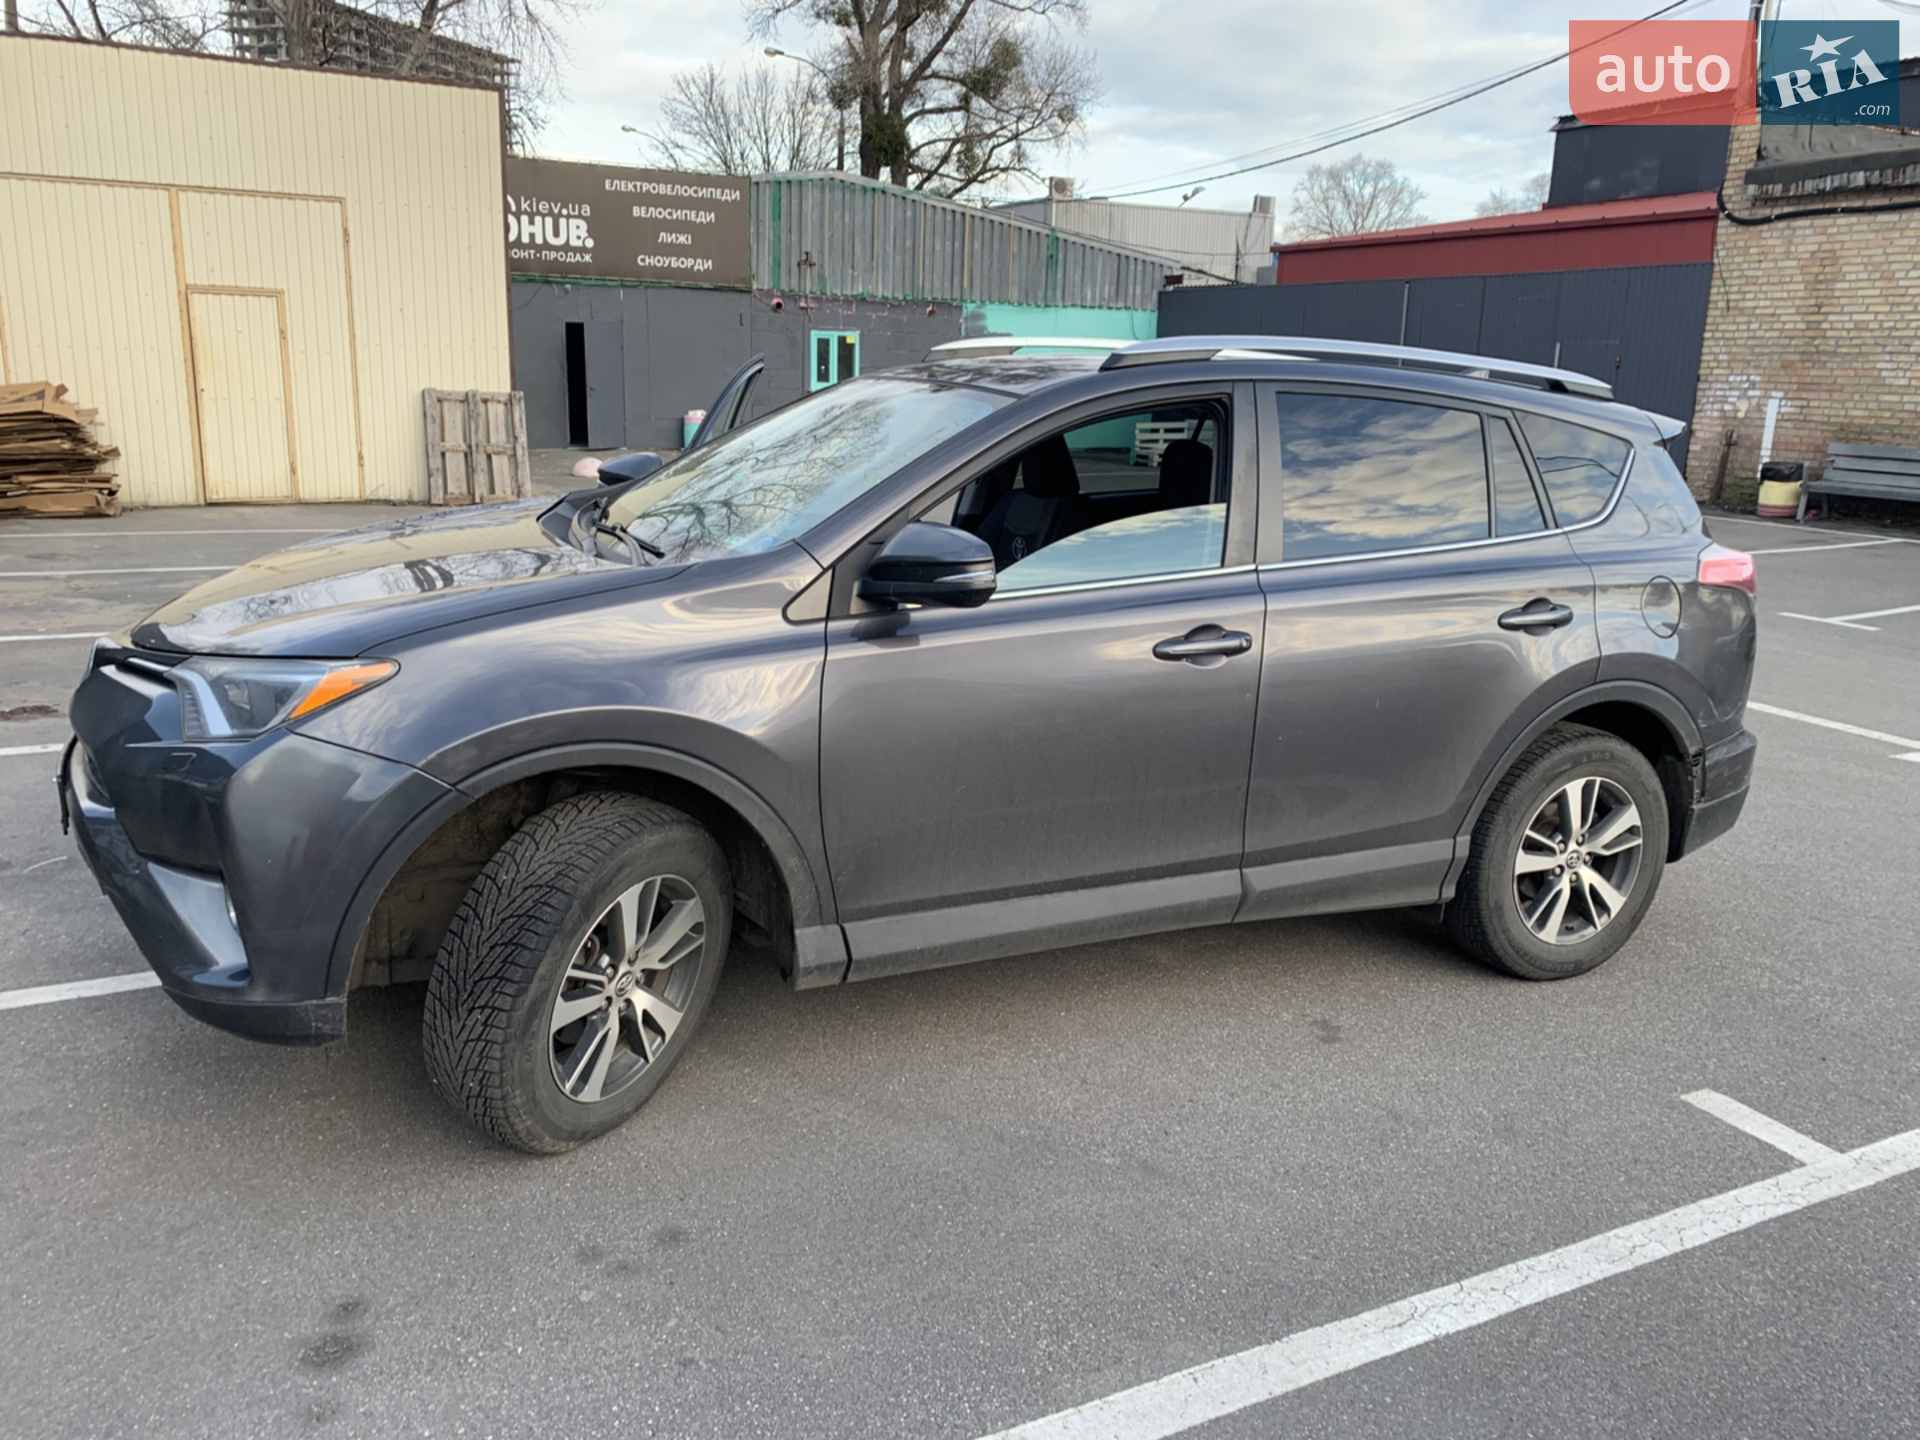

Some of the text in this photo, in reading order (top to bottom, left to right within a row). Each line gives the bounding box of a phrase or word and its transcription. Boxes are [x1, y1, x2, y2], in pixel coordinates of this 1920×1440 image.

[604, 178, 741, 201] ЕЛЕКТРОВЕЛОСИПЕДИ
[520, 195, 591, 217] kiev.ua
[632, 205, 716, 224] ВЕЛОСИПЕДИ
[657, 231, 692, 245] ЛИЖІ
[636, 254, 713, 272] СНОУБОРДИ
